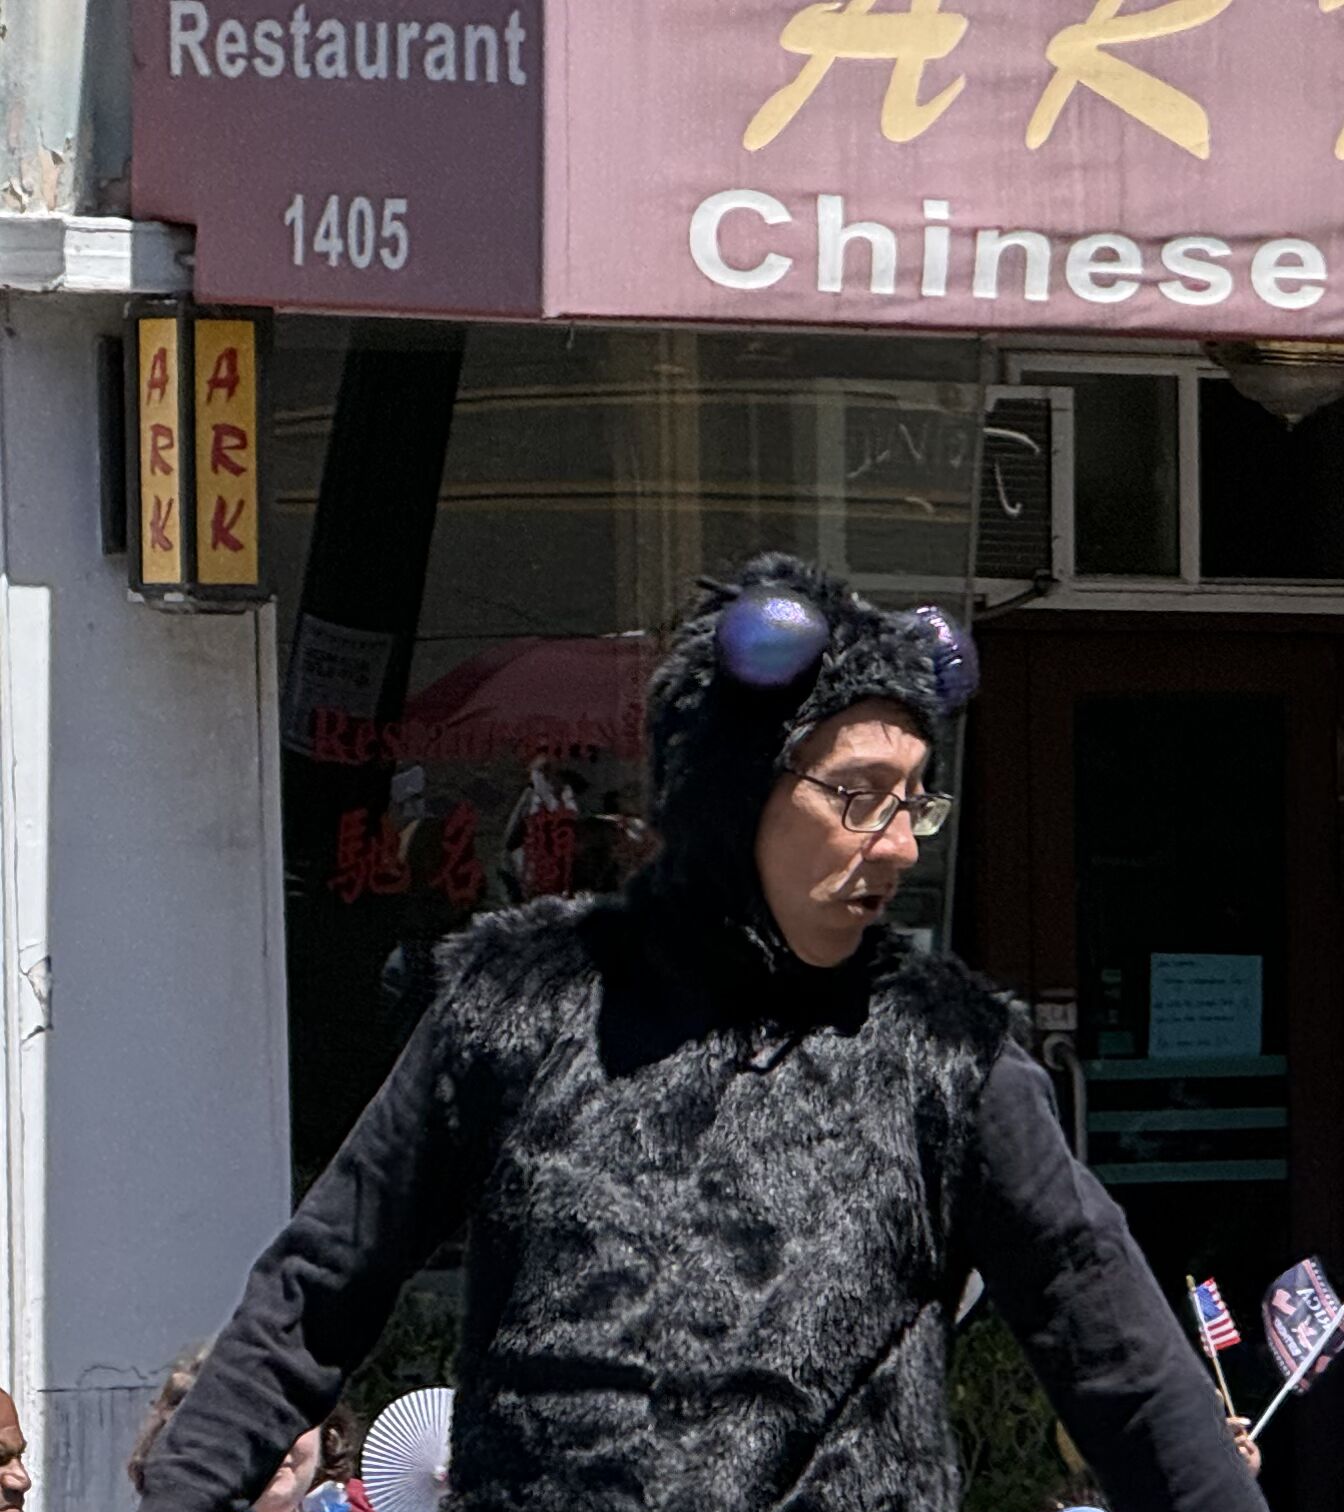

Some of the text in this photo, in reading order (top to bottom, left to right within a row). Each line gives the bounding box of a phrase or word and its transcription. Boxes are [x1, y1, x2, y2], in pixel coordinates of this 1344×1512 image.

[169, 2, 528, 87] Restaurant
[284, 194, 409, 270] 1405
[689, 189, 1328, 310] Chinese
[207, 347, 249, 553] ARK
